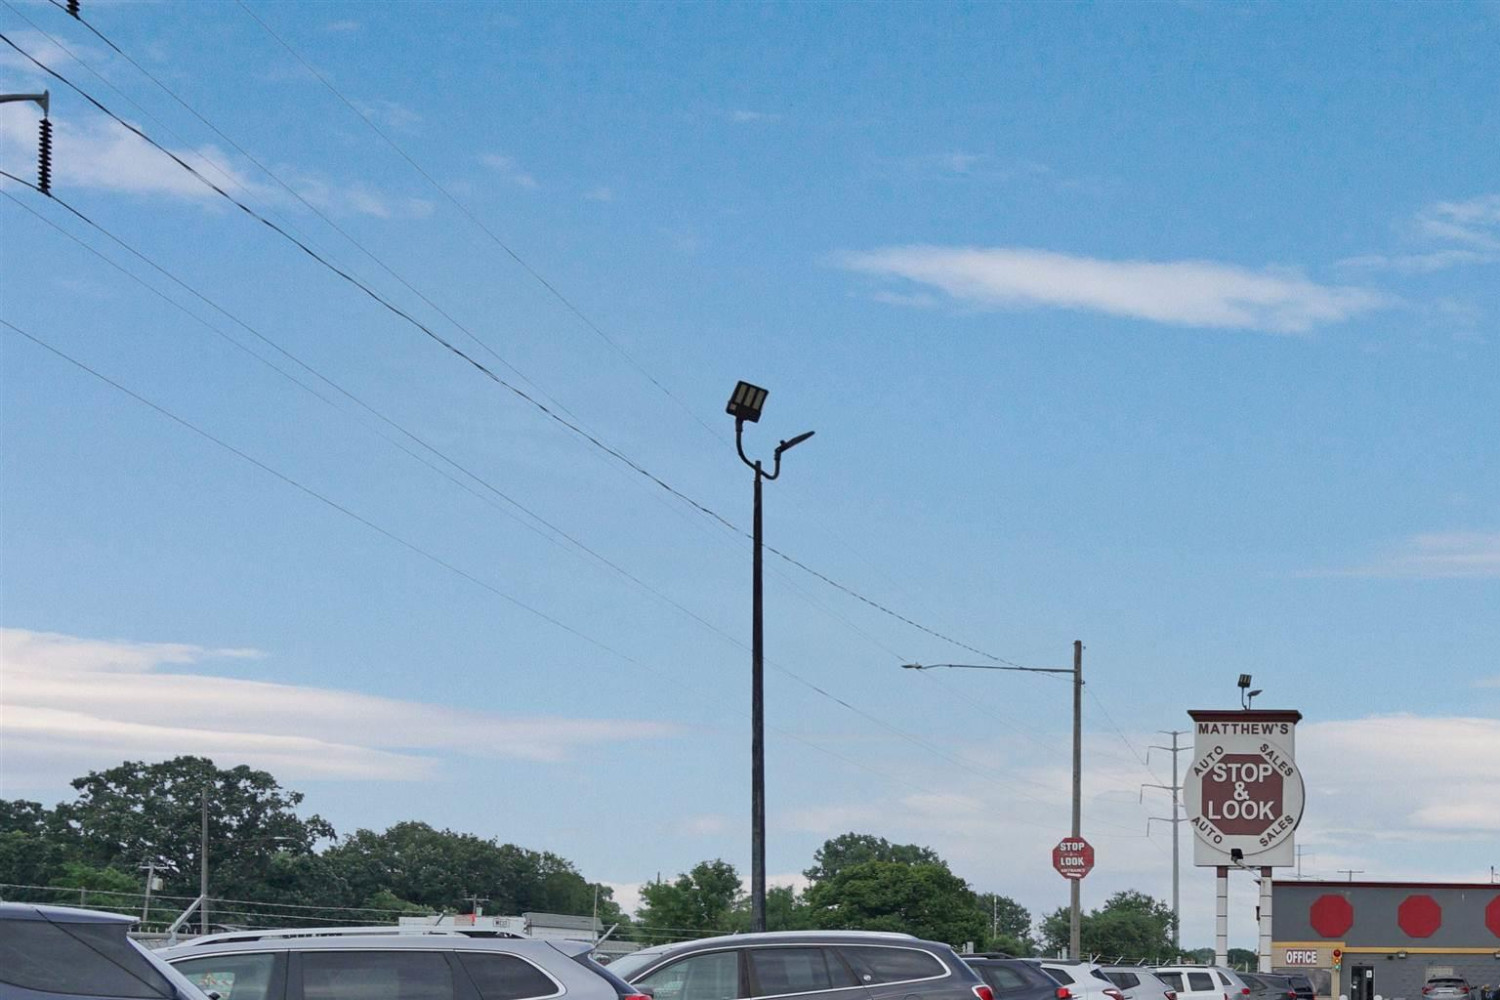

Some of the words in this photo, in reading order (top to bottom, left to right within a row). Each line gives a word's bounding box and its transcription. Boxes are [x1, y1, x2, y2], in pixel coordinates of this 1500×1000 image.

[1198, 723, 1289, 735] MATTHEW'S
[1193, 745, 1224, 777] AUTO
[1259, 743, 1294, 777] SALES
[1212, 763, 1273, 783] STOP
[1233, 781, 1250, 801] &
[1208, 800, 1275, 820] LOOK
[1192, 816, 1223, 845] AUTO
[1259, 814, 1294, 847] SALES
[1060, 842, 1085, 851] STOP
[1060, 857, 1085, 866] LOOK
[1286, 951, 1317, 964] OFFICE
